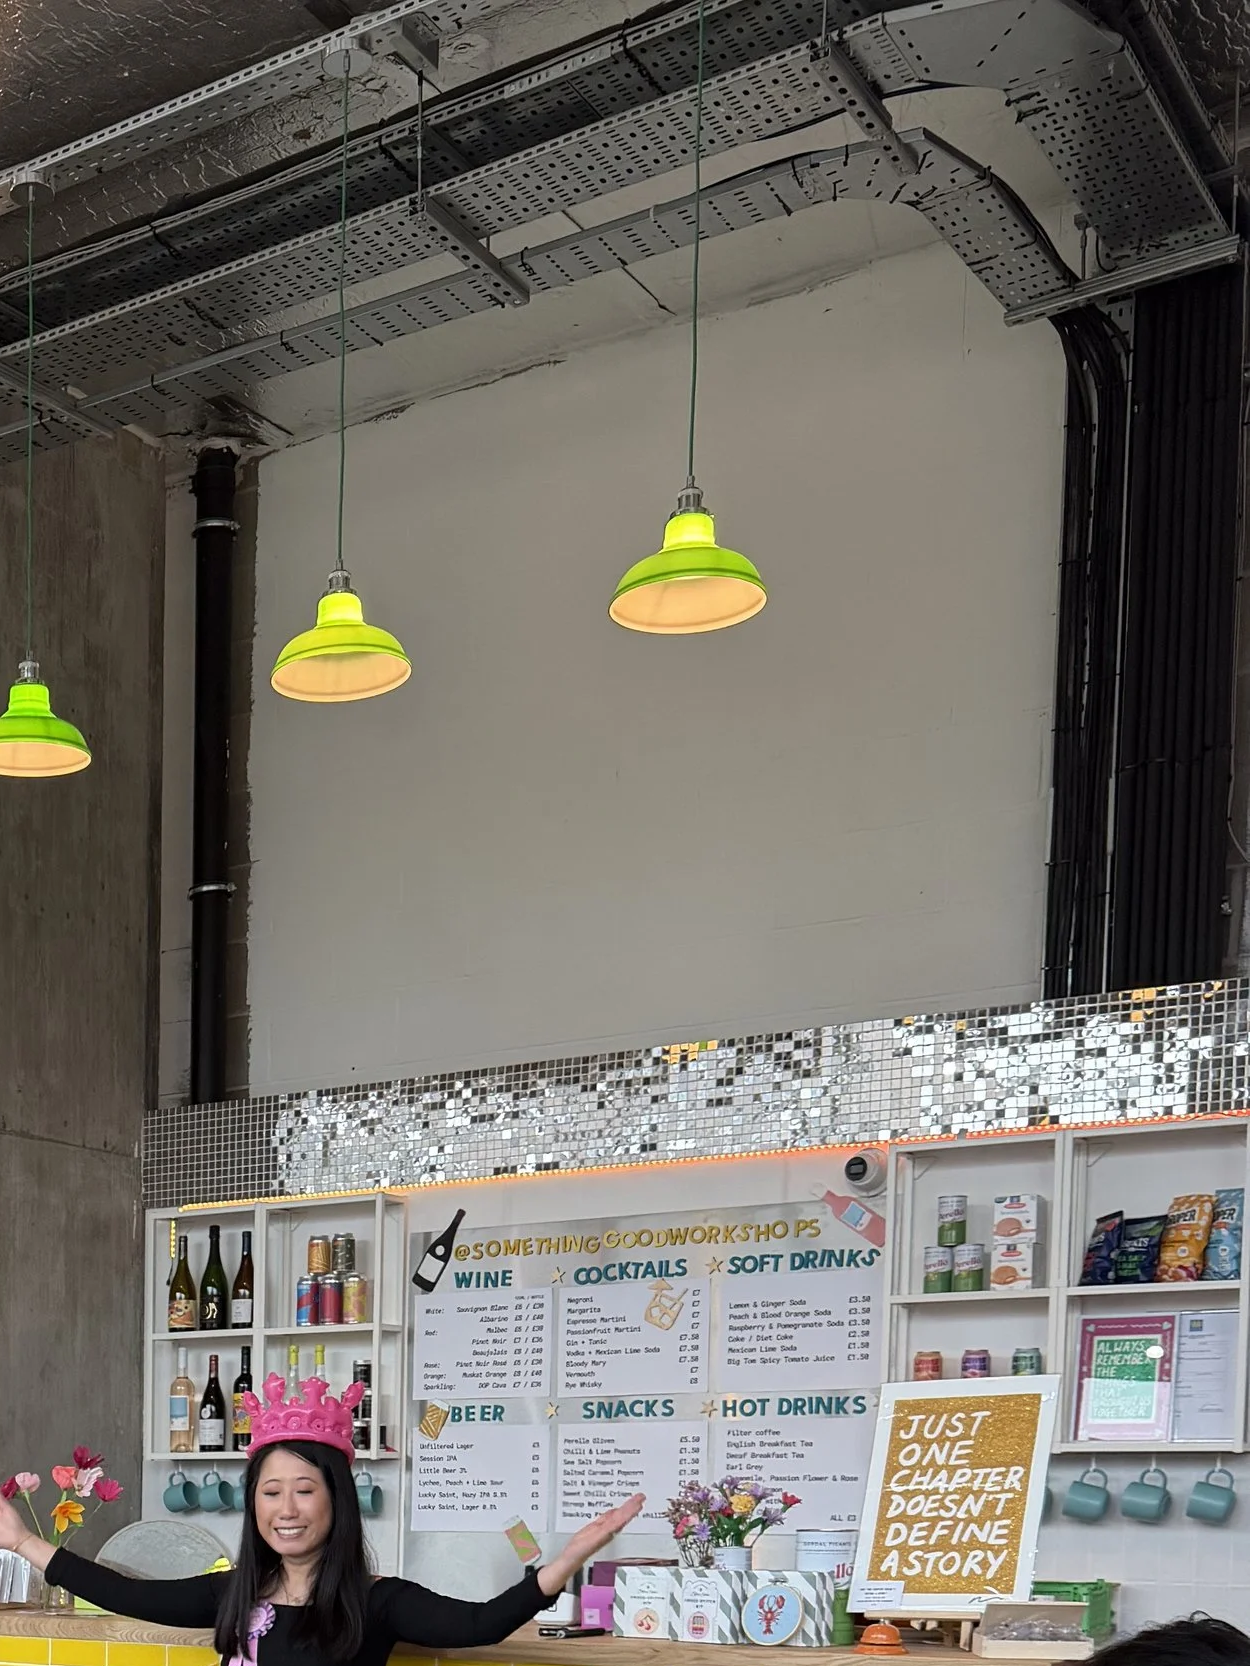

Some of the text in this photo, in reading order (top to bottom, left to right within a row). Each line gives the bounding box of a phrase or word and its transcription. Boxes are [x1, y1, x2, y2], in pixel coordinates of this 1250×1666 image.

[574, 1258, 687, 1285] COCKTAILS
[727, 1248, 882, 1275] SOFT DRINKS
[454, 1269, 513, 1289] WINE
[761, 1301, 786, 1309] Ginger
[729, 1324, 765, 1332] Raspberry
[777, 1321, 823, 1329] Pomegranate
[848, 1342, 869, 1350] £1.50
[1097, 1340, 1146, 1353] ALWAYS
[727, 1358, 740, 1366] Big
[760, 1357, 781, 1365] Spicy
[450, 1405, 505, 1422] BEER
[582, 1399, 674, 1419] SNACKS
[722, 1396, 867, 1417] HOT DRINKS
[900, 1411, 991, 1440] JUST
[898, 1440, 975, 1467] ONE
[746, 1463, 763, 1471] Grey
[888, 1466, 1025, 1493] CHAPTER
[885, 1493, 1014, 1518] DOESN'T
[884, 1519, 1012, 1547] DEFINE
[880, 1549, 900, 1577] A
[902, 1549, 1009, 1579] STORY
